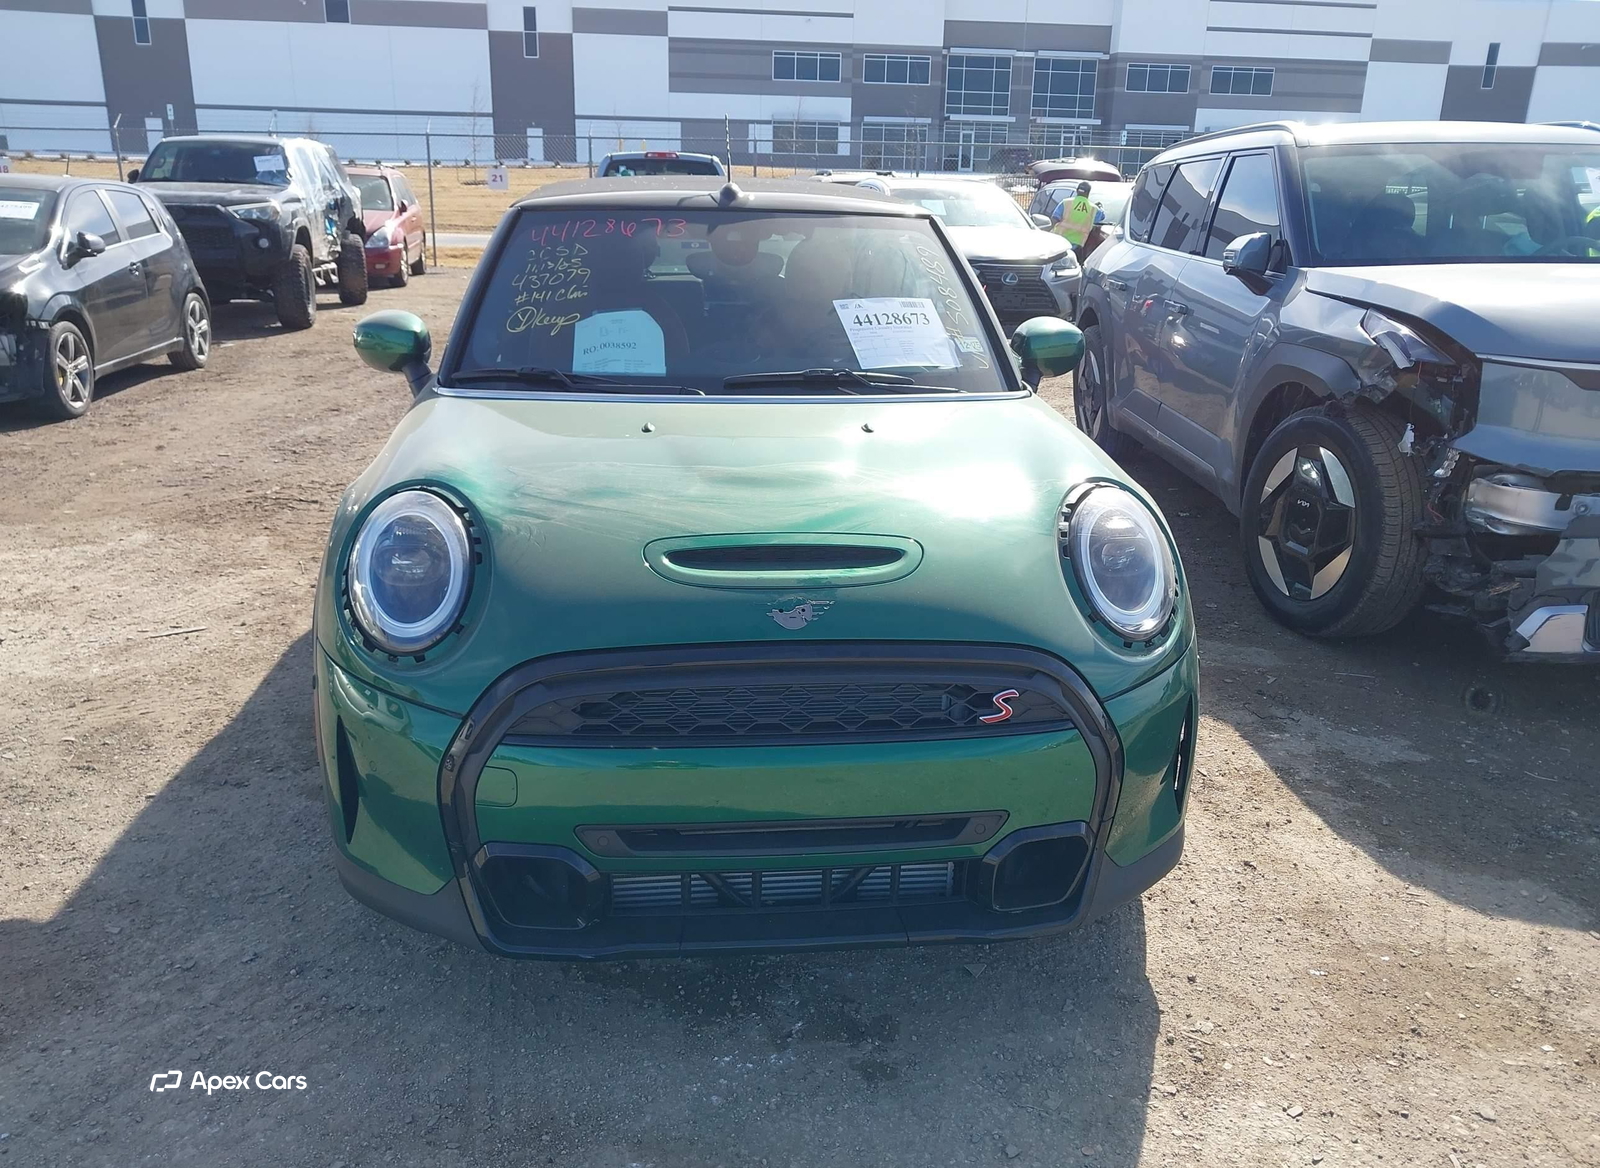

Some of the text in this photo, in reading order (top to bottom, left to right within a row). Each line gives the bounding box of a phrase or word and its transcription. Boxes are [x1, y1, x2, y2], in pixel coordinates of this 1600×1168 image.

[491, 174, 503, 183] 21
[531, 218, 687, 246] 44128673
[511, 268, 591, 291] 437079
[853, 312, 930, 327] 44128673
[979, 689, 1019, 723] S
